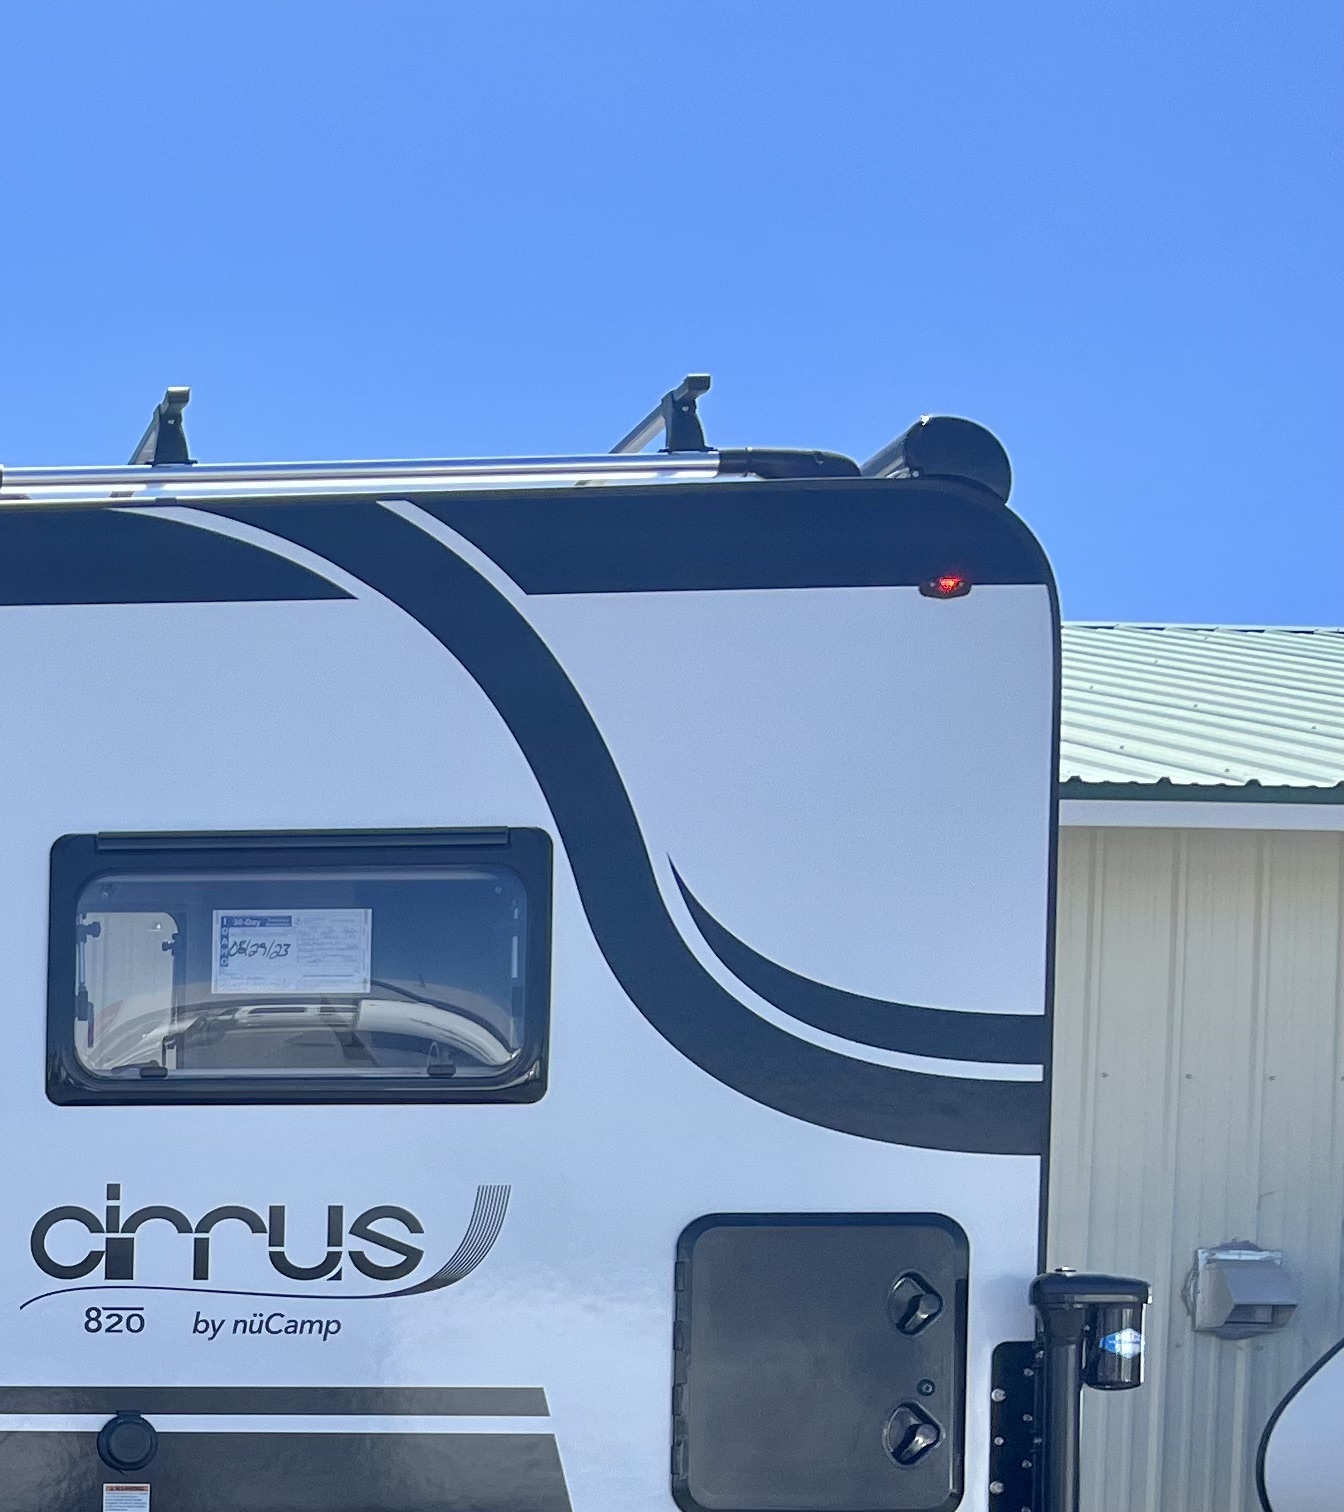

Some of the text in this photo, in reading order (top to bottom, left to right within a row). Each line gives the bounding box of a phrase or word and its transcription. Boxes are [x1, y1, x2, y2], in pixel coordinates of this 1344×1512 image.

[29, 1182, 425, 1282] cirrus
[83, 1306, 146, 1335] 820
[191, 1311, 342, 1341] by nüCamp
